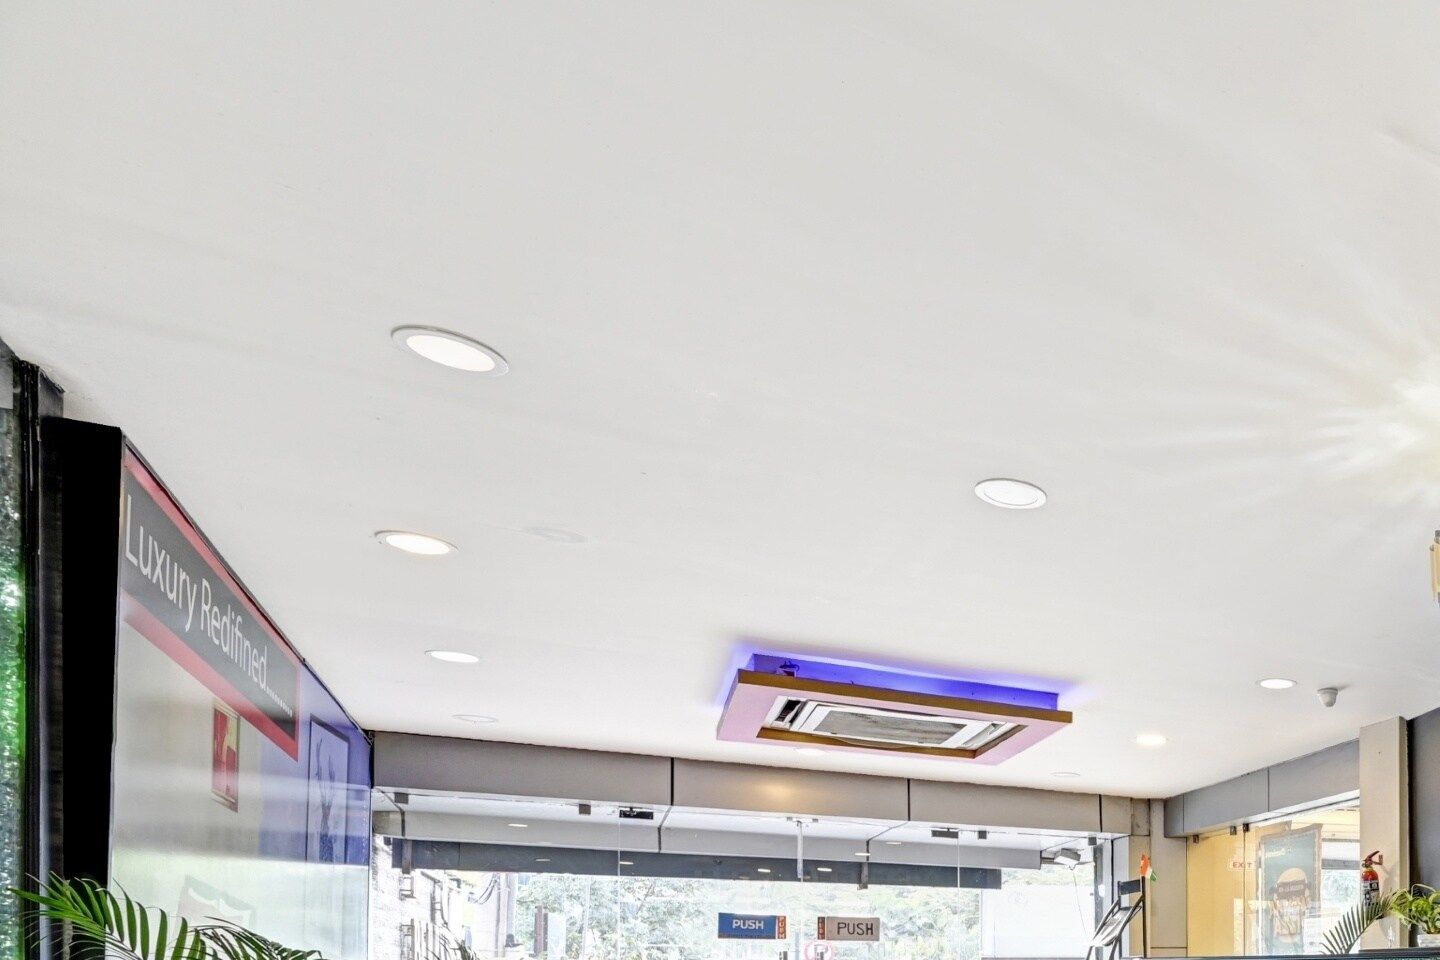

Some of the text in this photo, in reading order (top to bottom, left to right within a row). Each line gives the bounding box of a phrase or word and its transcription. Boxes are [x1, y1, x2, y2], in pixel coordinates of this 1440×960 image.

[125, 494, 198, 633] Luxury
[1232, 861, 1253, 869] EXT
[732, 918, 764, 930] PUSH
[837, 922, 874, 936] PUSH
